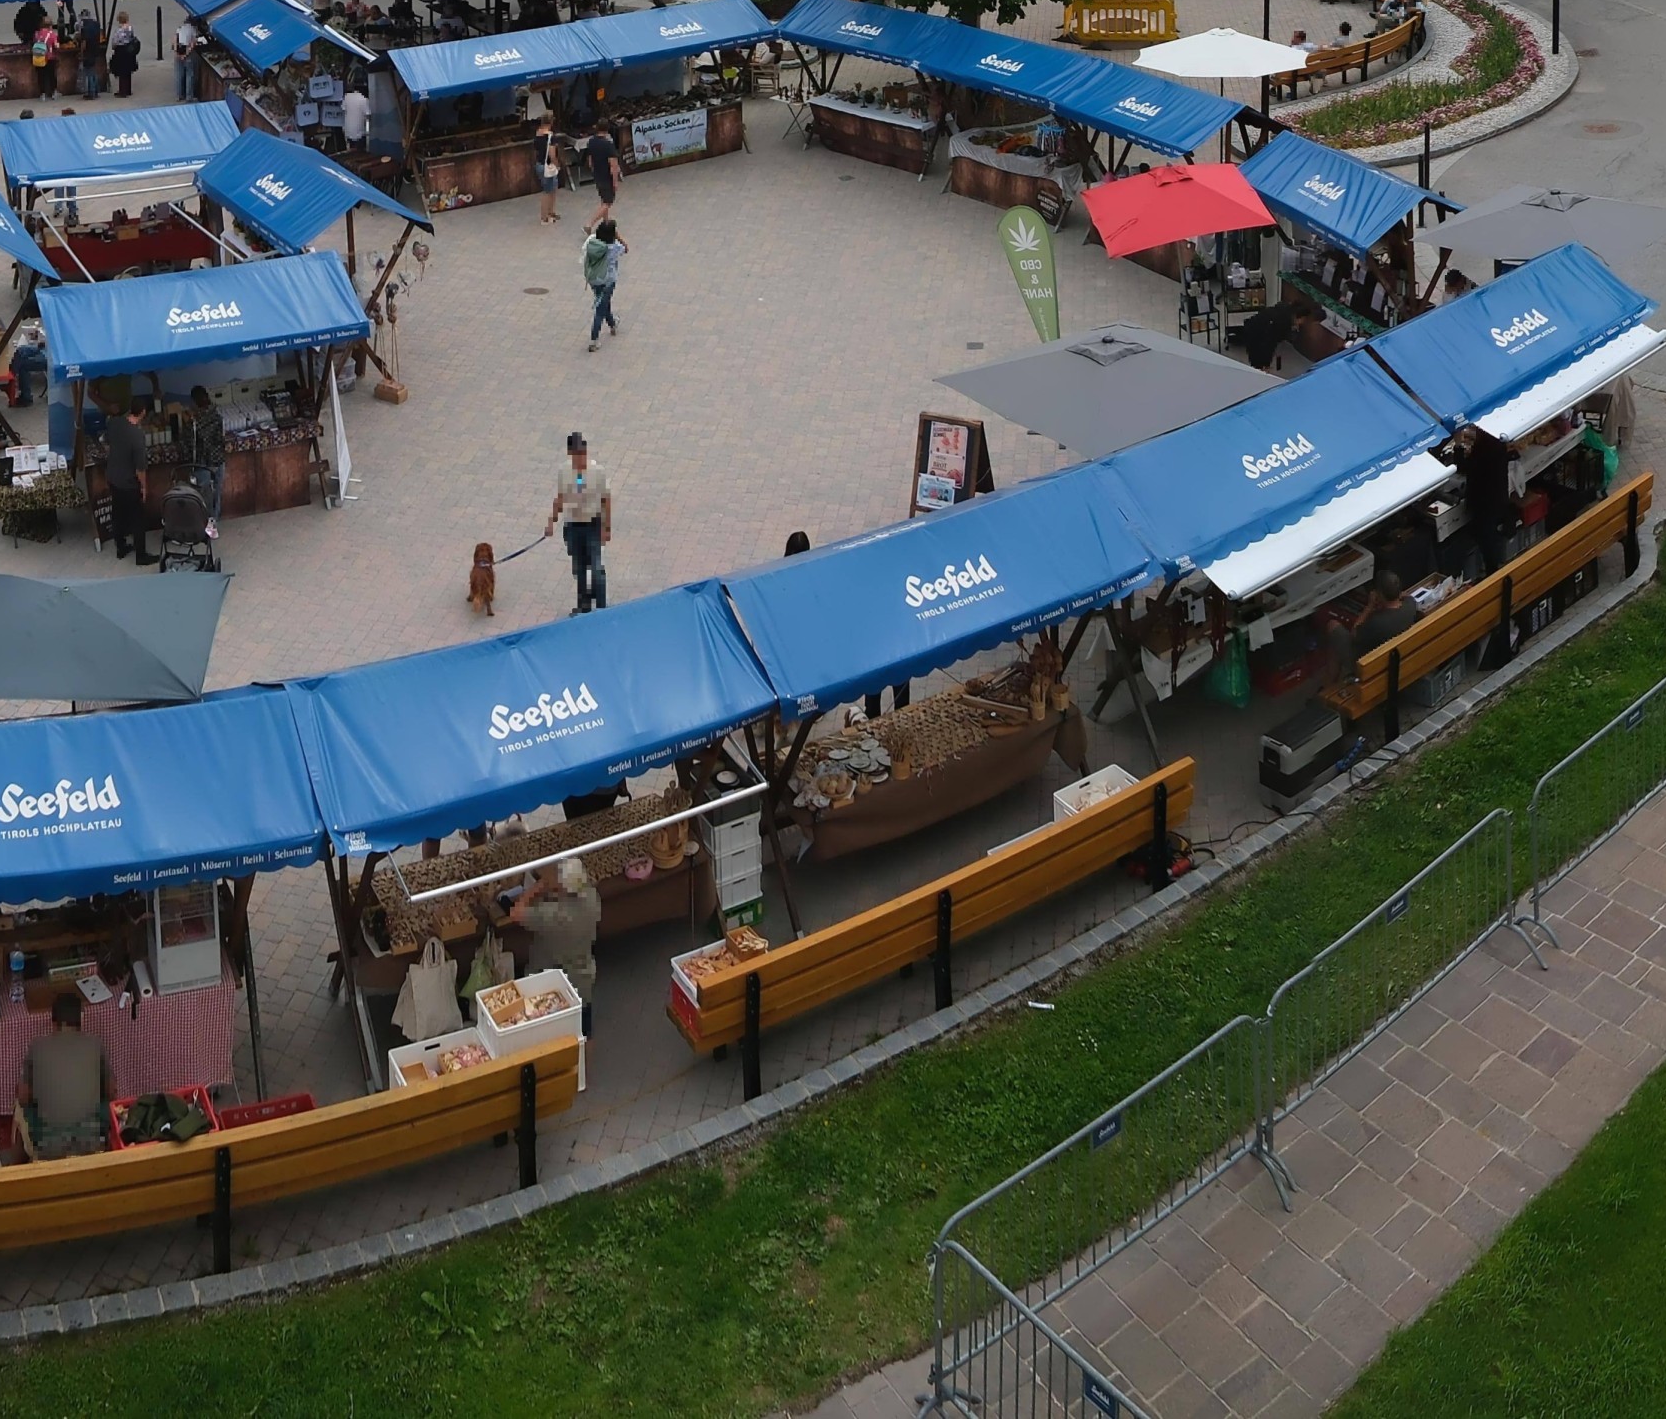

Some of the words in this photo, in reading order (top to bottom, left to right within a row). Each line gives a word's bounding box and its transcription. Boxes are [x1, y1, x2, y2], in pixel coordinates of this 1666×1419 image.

[659, 22, 703, 37] Seefeld
[841, 20, 884, 37] Seefeld
[474, 49, 522, 66] Seefeld
[980, 54, 1025, 73] Seefeld
[1118, 96, 1162, 118] Seefeld
[93, 131, 151, 149] Seefeld
[634, 118, 691, 135] Alpaka-Socken
[1304, 174, 1346, 201] Seefeld
[166, 300, 241, 327] Seefeld
[196, 320, 244, 332] HOCHPLATEAU
[1490, 308, 1549, 349] Seefeld
[1242, 432, 1315, 479] Seefeld
[1256, 471, 1280, 489] TIROLS
[904, 553, 998, 608] Seefeld
[915, 605, 946, 621] TIROLS
[946, 585, 1005, 612] HOCHPLATEAU
[1010, 618, 1032, 633] Seefeld
[1039, 606, 1065, 623] Leutasch
[1072, 594, 1094, 609] Mösern
[1099, 585, 1116, 598] Reith
[1121, 570, 1149, 590] Scharnitz
[489, 682, 599, 741] Seefeld
[498, 738, 534, 755] TIROLS
[535, 718, 605, 747] HOCHPLATEAU
[608, 759, 633, 776] Seefeld
[641, 747, 672, 766] Leutasch
[682, 735, 707, 753] Mösern
[716, 725, 734, 739] Reith
[0, 826, 40, 841] TIROLS
[43, 817, 123, 837] HOCHPLATEAU
[113, 869, 142, 885] Seefeld
[152, 863, 190, 879] Leutasch
[200, 856, 232, 872] Mösern
[242, 851, 265, 865] Reith
[274, 844, 313, 861] Scharnitz
